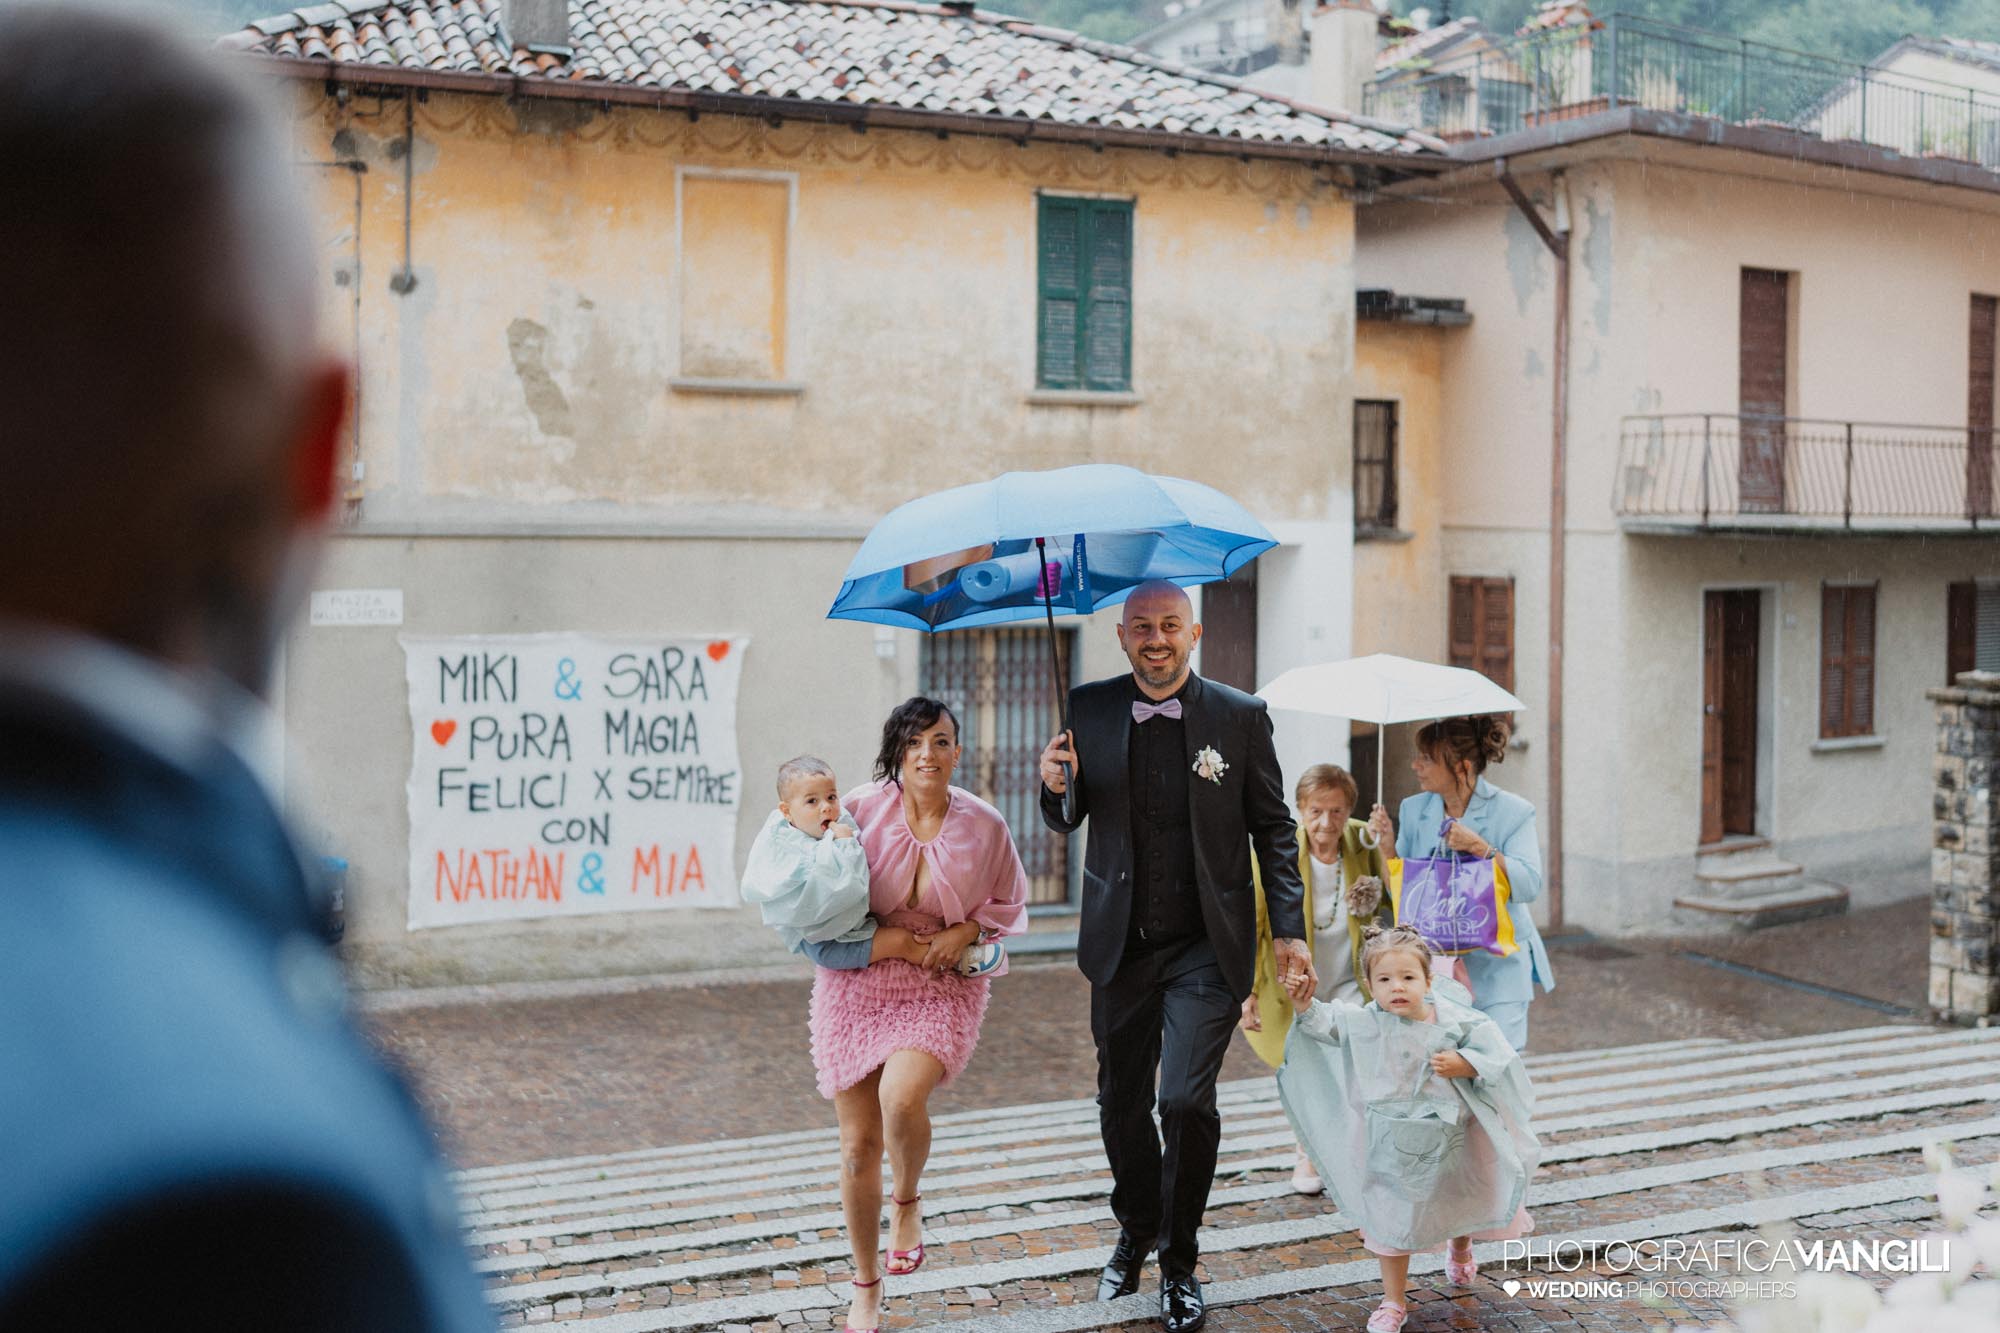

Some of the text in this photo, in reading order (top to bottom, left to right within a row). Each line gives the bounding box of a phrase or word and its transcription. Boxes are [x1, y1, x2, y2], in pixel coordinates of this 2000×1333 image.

[439, 647, 708, 703] MIKI & SARA
[469, 709, 700, 762] PURA MAGIA
[438, 768, 567, 812] FELICI
[627, 765, 736, 806] SEMPRE
[541, 813, 611, 846] CON
[435, 844, 706, 903] NATHAN & MIA
